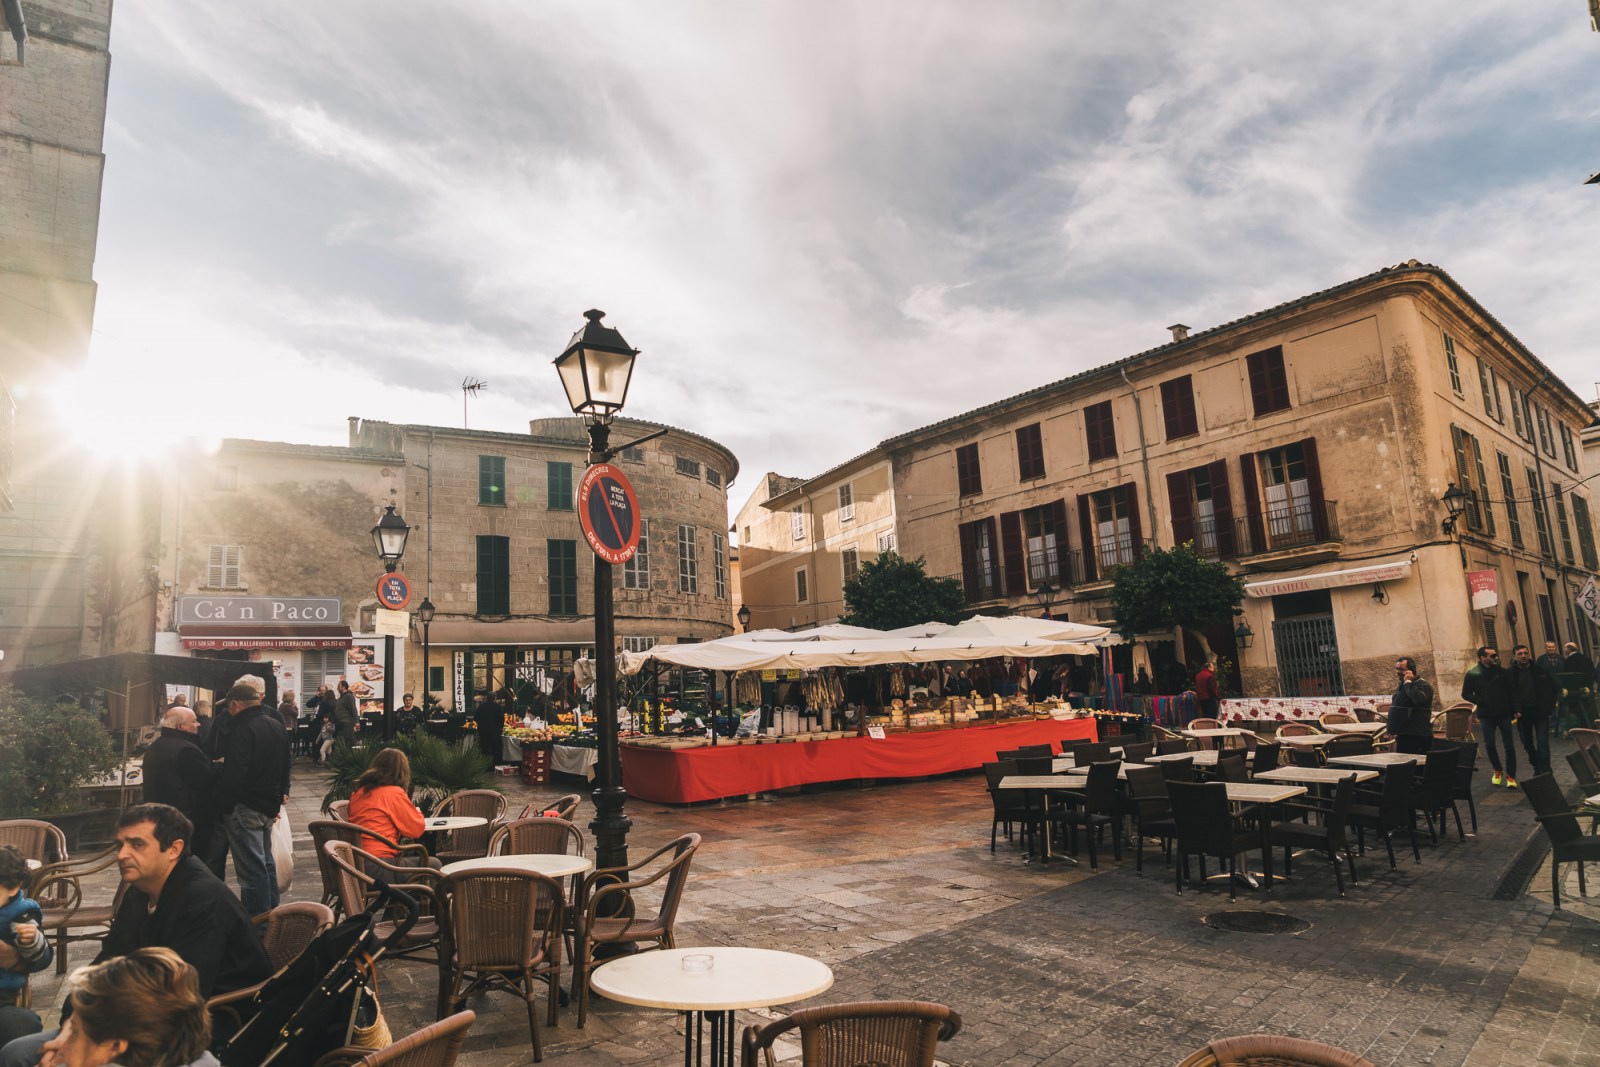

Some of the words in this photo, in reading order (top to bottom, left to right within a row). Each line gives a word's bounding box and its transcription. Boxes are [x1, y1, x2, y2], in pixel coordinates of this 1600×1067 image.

[581, 485, 589, 501] ELS
[585, 466, 609, 486] DIMECRES
[610, 485, 625, 495] MERCAT
[615, 494, 625, 502] TOTA
[588, 532, 597, 544] DE
[271, 602, 328, 620] Paco
